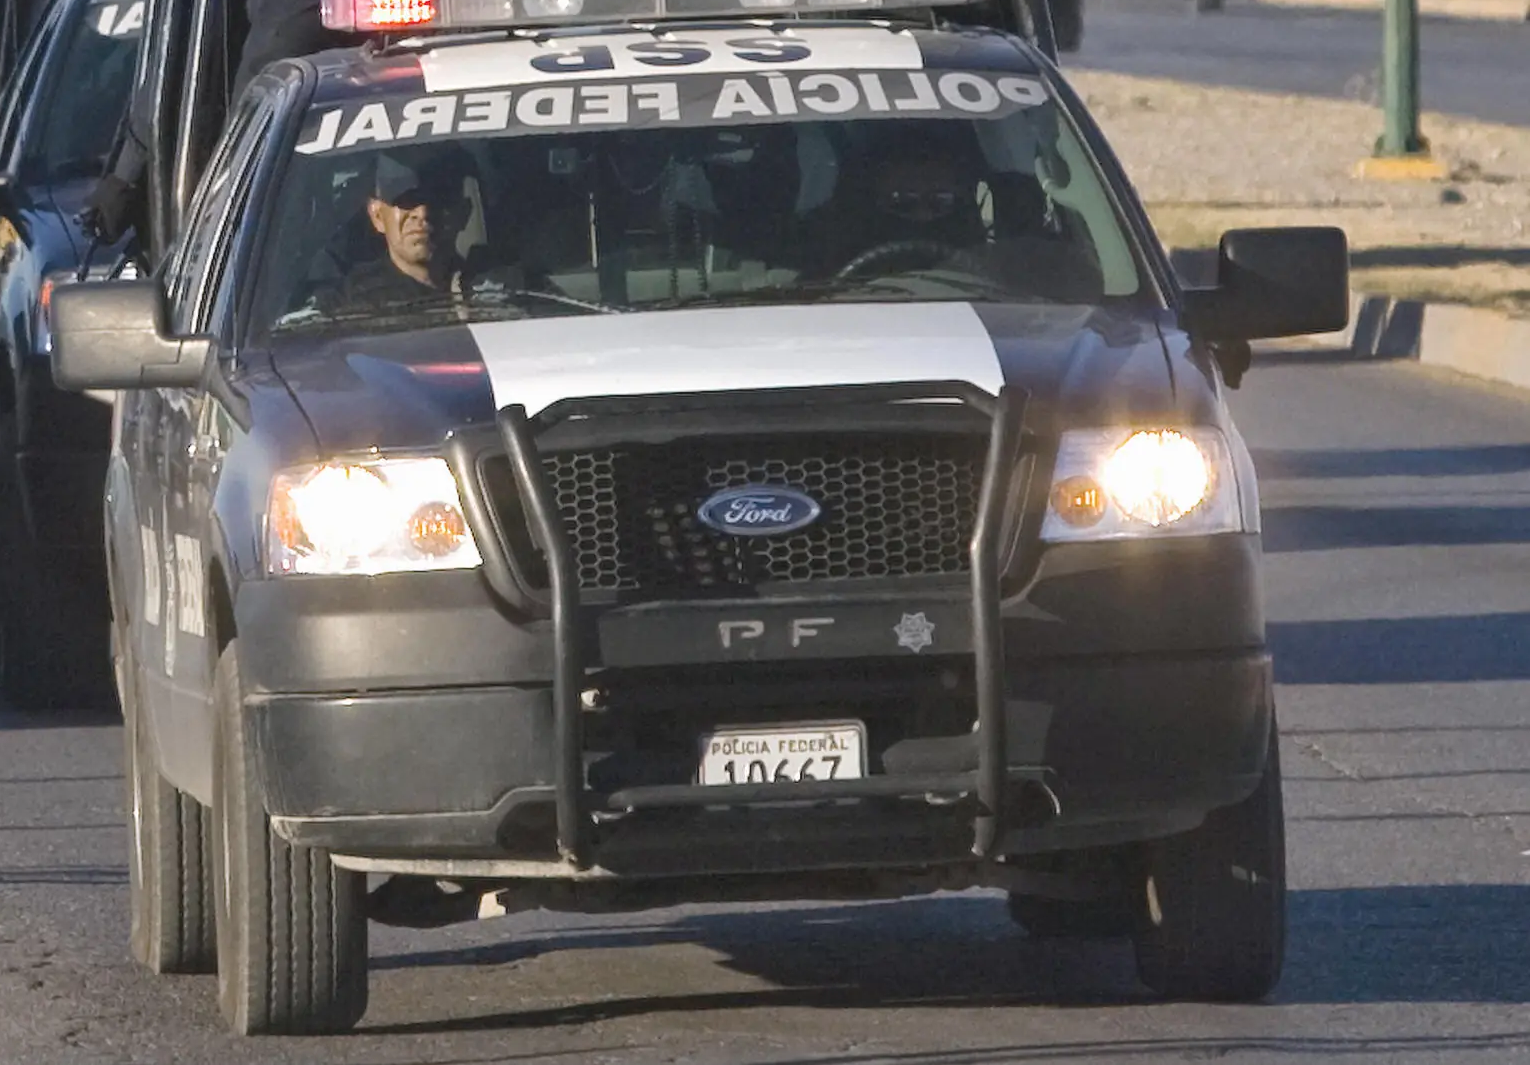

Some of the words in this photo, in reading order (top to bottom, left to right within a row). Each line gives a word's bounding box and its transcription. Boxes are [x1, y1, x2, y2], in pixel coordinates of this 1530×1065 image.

[724, 497, 793, 524] Ford
[711, 738, 771, 756] POLICIA
[778, 736, 849, 753] FEDERAL
